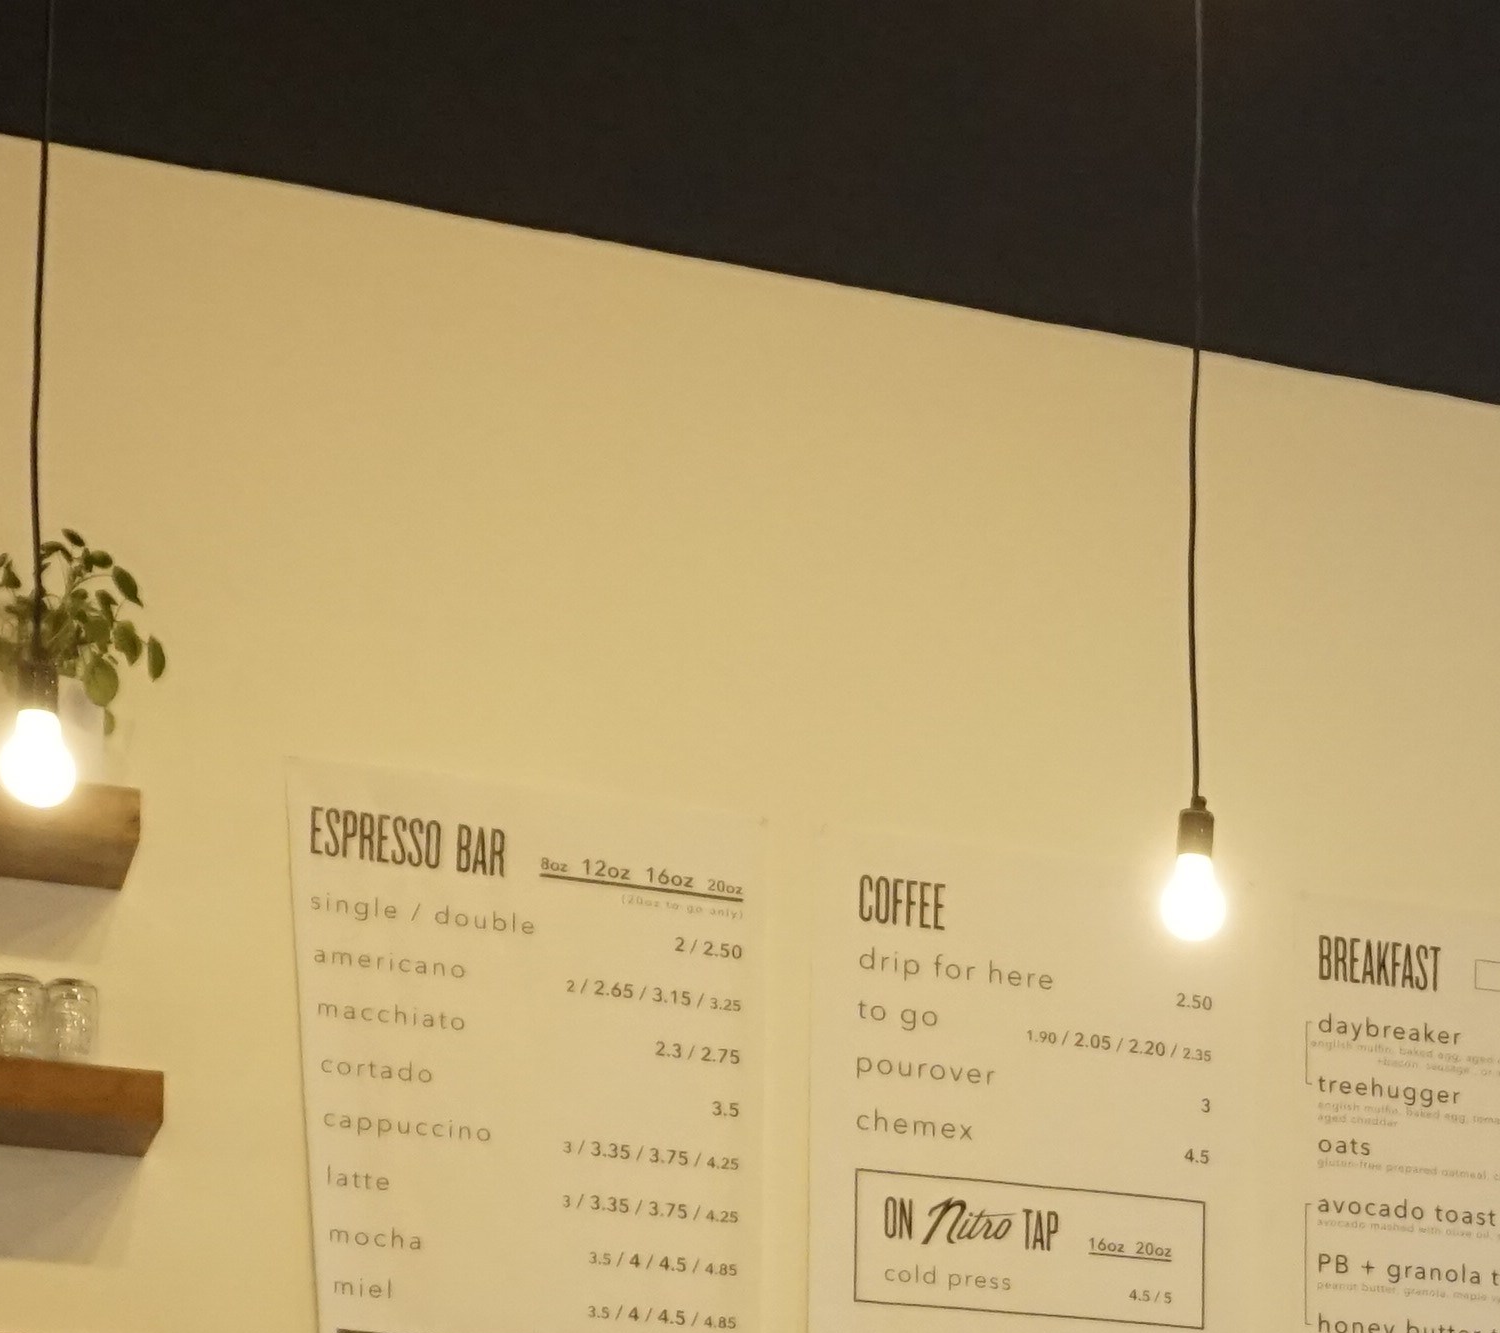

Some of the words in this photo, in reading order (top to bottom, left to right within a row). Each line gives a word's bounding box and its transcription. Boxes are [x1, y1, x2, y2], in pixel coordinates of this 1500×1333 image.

[309, 805, 442, 870] ESPRESSO
[456, 824, 506, 878] BAR
[540, 857, 569, 872] 8oz
[582, 858, 631, 880] 12oz
[647, 867, 694, 888] 16oz
[708, 879, 743, 895] 20oz
[310, 892, 398, 922] single
[434, 904, 535, 936] double
[858, 874, 947, 932] COFFEE
[313, 948, 467, 980] americano
[702, 940, 743, 960] 2.50
[1318, 934, 1442, 993] BREAKFAST
[858, 946, 921, 982] drip
[933, 953, 976, 981] for
[988, 959, 1054, 991] here
[594, 979, 634, 999] 2.65
[652, 986, 692, 1007] 3.15
[710, 997, 742, 1013] 3.25
[1175, 992, 1213, 1012] 2.50
[317, 1002, 466, 1032] macchiato
[857, 1000, 887, 1022] to
[900, 1008, 939, 1032] go
[1317, 1012, 1461, 1046] daybreaker
[700, 1046, 741, 1065] 2.75
[1026, 1029, 1058, 1045] 1.90
[1073, 1031, 1112, 1051] 2.05
[1128, 1038, 1166, 1057] 2.20
[1182, 1047, 1212, 1063] 2.35
[320, 1058, 434, 1084] cortado
[855, 1056, 996, 1086] pourover
[1201, 1097, 1211, 1114] 3
[1317, 1075, 1461, 1109] treehugger
[712, 1100, 740, 1118] 3.5
[323, 1112, 492, 1143] cappuccino
[855, 1108, 973, 1141] chemex
[591, 1140, 631, 1161] 3.35
[649, 1147, 689, 1167] 3.75
[706, 1156, 740, 1171] 4.25
[1183, 1148, 1210, 1165] 4.5
[1317, 1138, 1371, 1157] oats
[326, 1164, 390, 1192] latte
[590, 1194, 630, 1214] 3.35
[648, 1200, 688, 1220] 3.75
[705, 1209, 739, 1224] 4.25
[883, 1196, 914, 1241] ON
[921, 1197, 1013, 1246] Nitro
[1022, 1208, 1060, 1252] TAP
[1317, 1198, 1425, 1224] avocado
[1434, 1205, 1496, 1227] toast
[329, 1227, 423, 1251] mocha
[1088, 1237, 1125, 1254] 16oz
[1136, 1241, 1172, 1258] 20oz
[588, 1251, 612, 1266] 3.5
[629, 1253, 641, 1268] 4
[658, 1255, 687, 1273] 4.5
[1317, 1252, 1349, 1275] PB
[1386, 1263, 1481, 1285] granola
[333, 1278, 393, 1299] miel
[883, 1263, 937, 1286] cold
[947, 1273, 1012, 1292] press
[1128, 1288, 1151, 1302] 4.5
[1163, 1291, 1173, 1305] 5
[588, 1305, 611, 1320] 3.5
[628, 1306, 640, 1322] 4
[657, 1308, 686, 1326] 4.5
